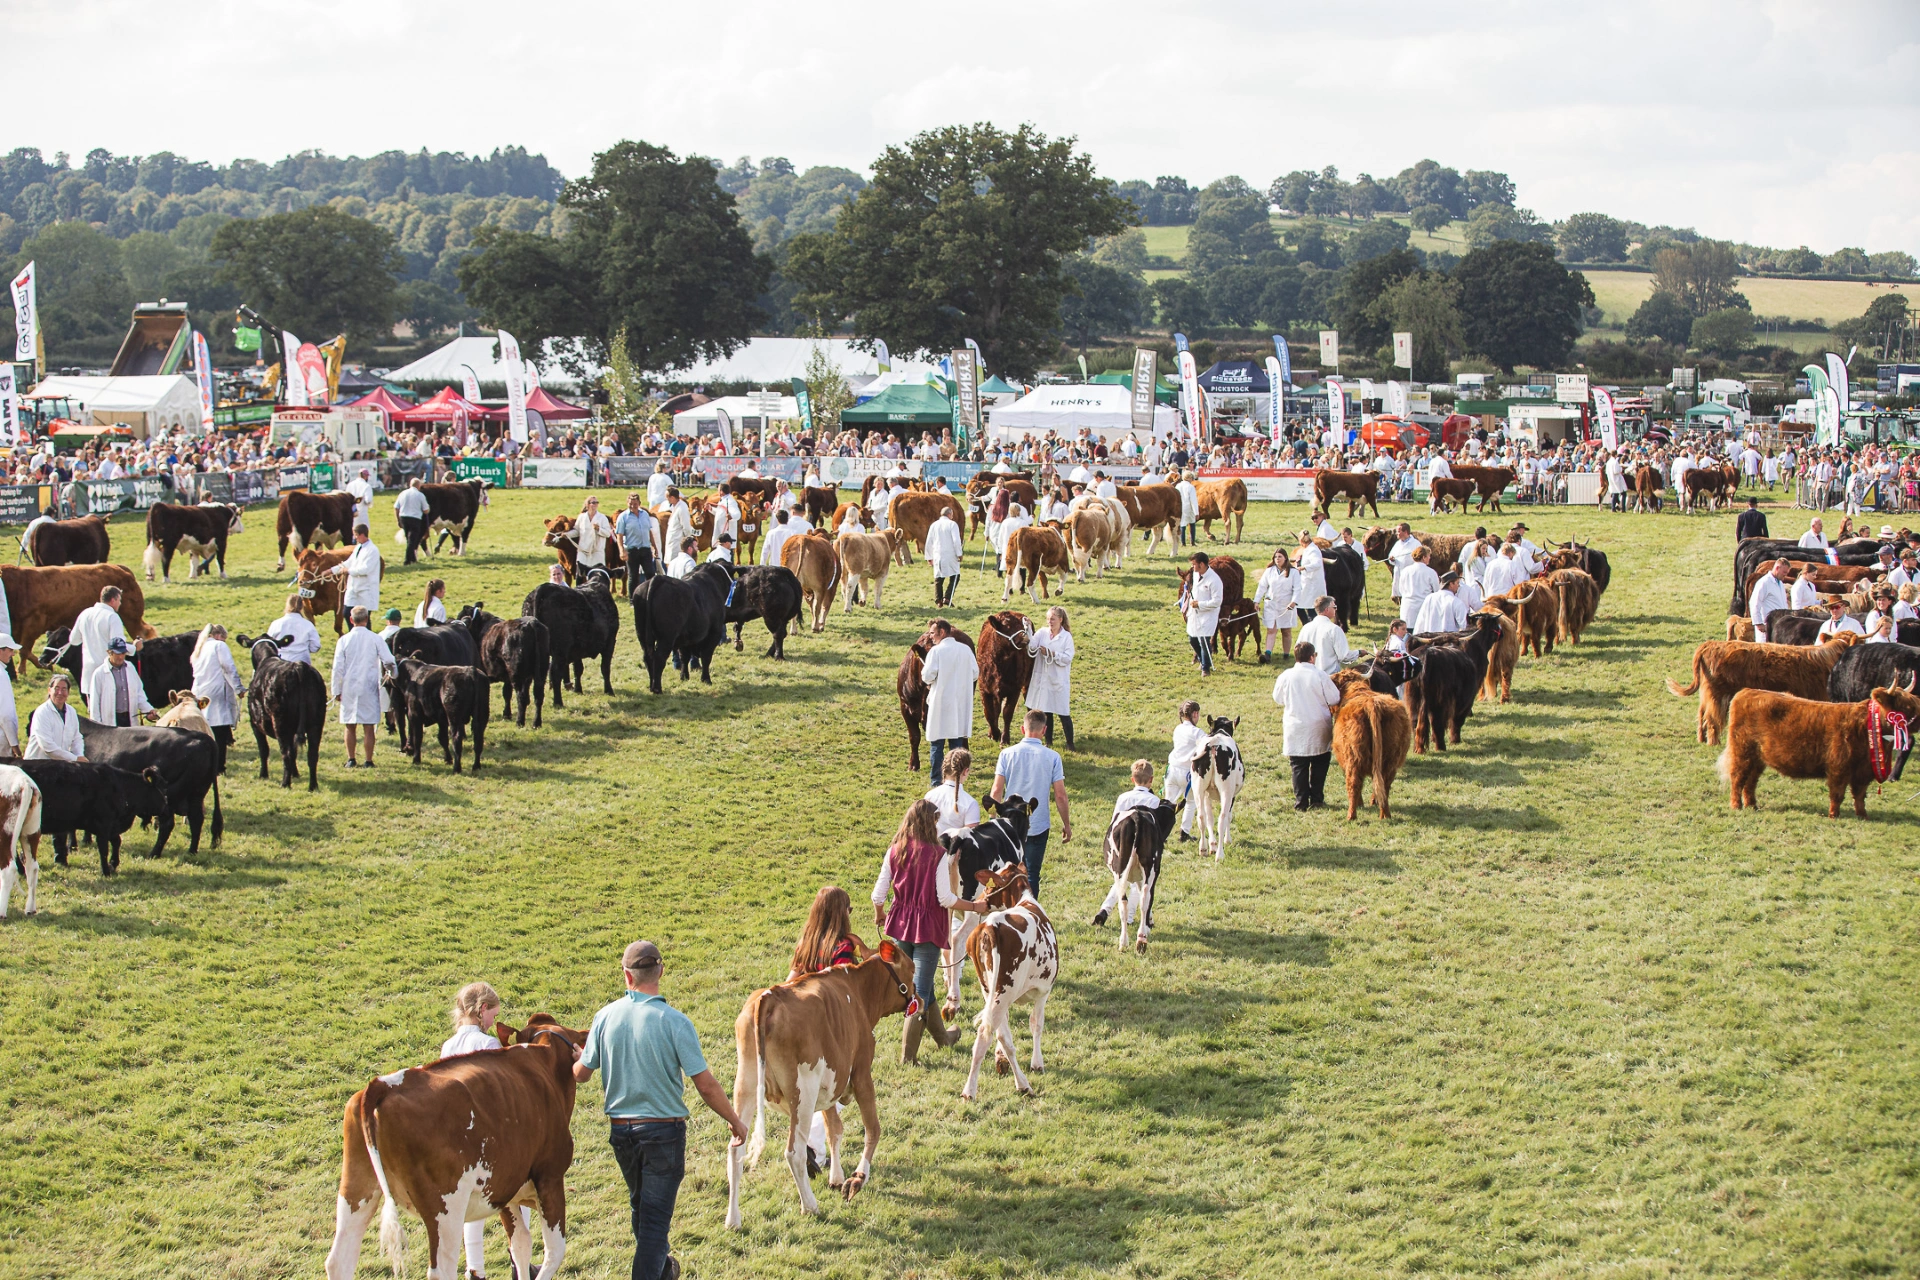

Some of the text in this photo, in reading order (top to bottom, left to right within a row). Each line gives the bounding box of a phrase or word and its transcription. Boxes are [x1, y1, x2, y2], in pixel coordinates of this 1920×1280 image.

[471, 466, 501, 476] Hunt's
[770, 463, 786, 471] ART
[102, 483, 124, 498] Knight
[102, 499, 121, 512] Frank
